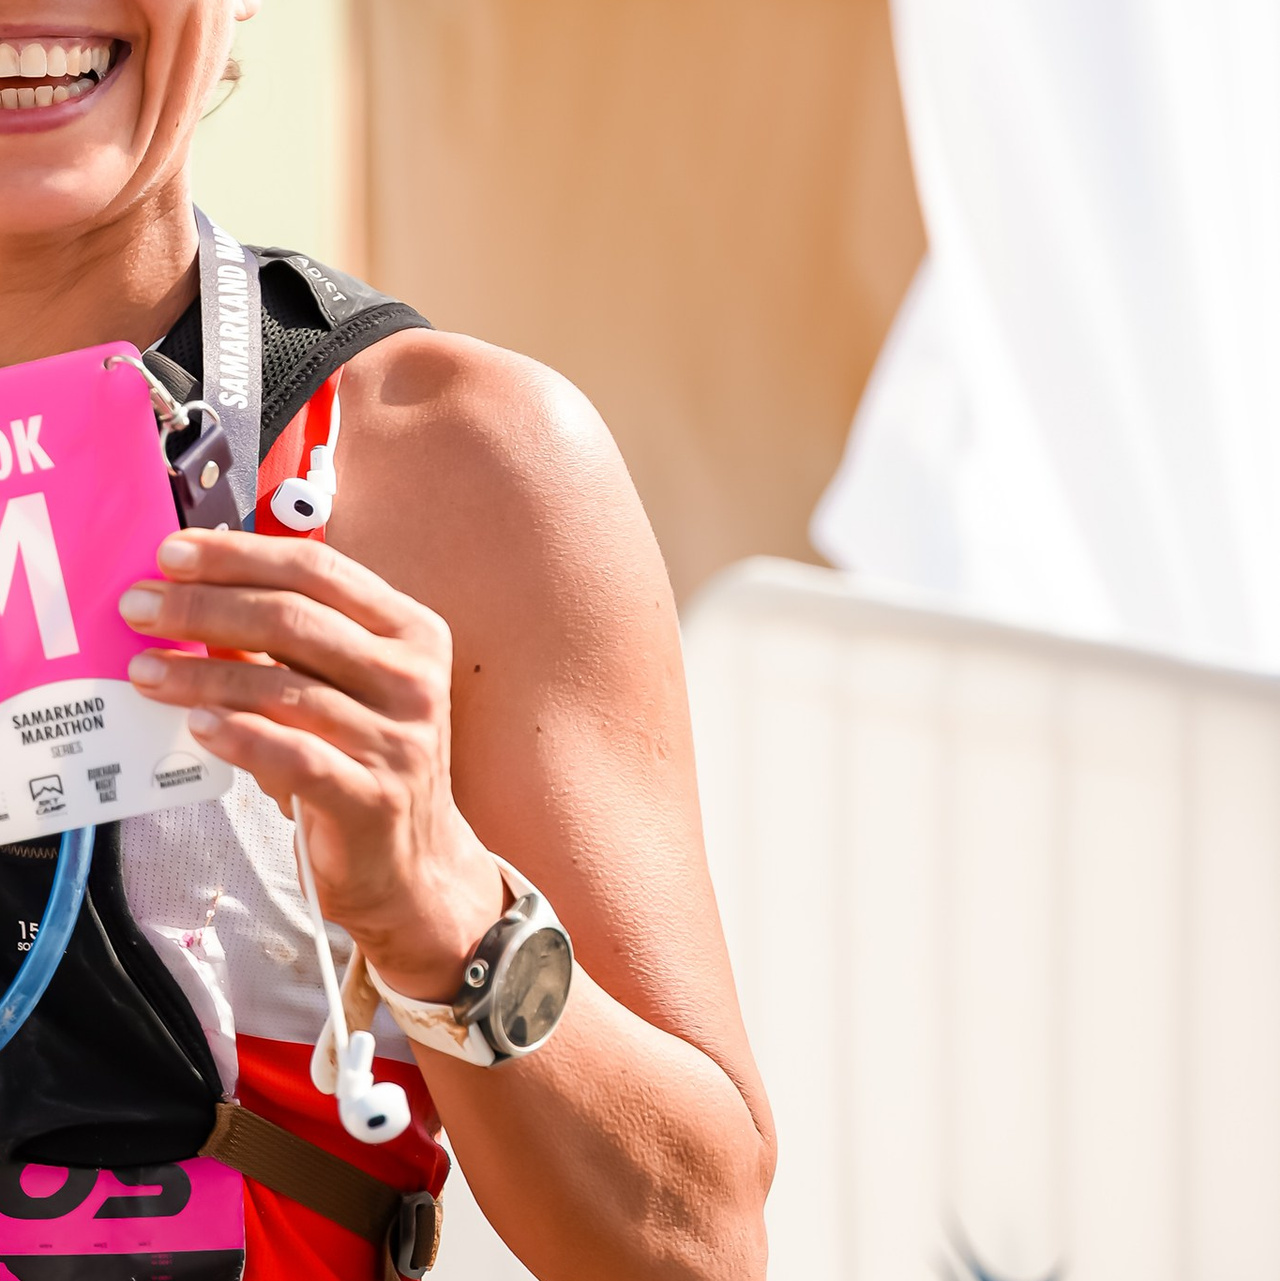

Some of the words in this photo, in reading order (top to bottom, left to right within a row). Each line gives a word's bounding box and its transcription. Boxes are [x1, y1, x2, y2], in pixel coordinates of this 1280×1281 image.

[217, 265, 250, 410] SAMARKAND
[12, 697, 105, 729] SAMARKAND
[21, 714, 105, 746] MARATHON
